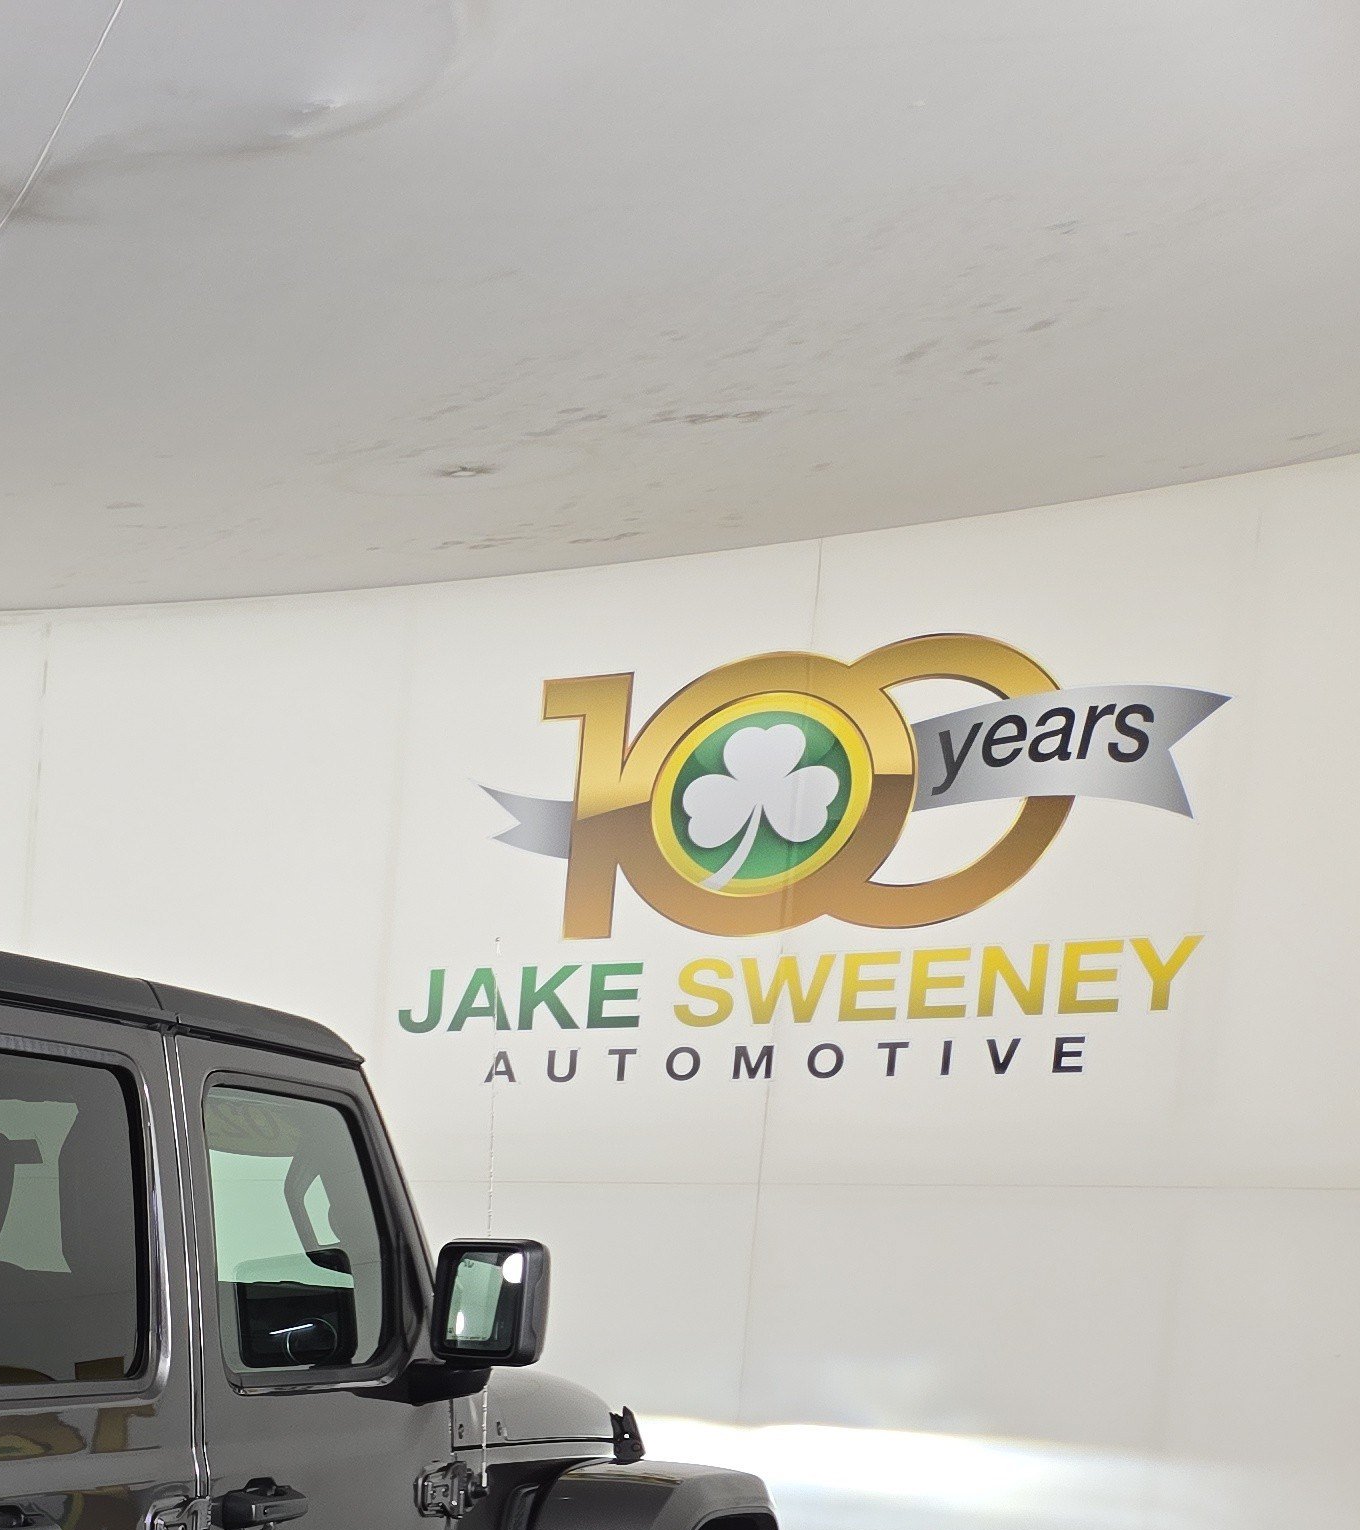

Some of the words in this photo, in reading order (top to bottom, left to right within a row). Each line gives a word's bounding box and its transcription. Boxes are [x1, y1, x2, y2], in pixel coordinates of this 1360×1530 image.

[541, 632, 1076, 940] 100
[931, 702, 1155, 797] years
[397, 961, 644, 1034] JAKE
[673, 933, 1205, 1029] SWEENEY
[483, 1035, 1086, 1084] AUTOMOTIVE
